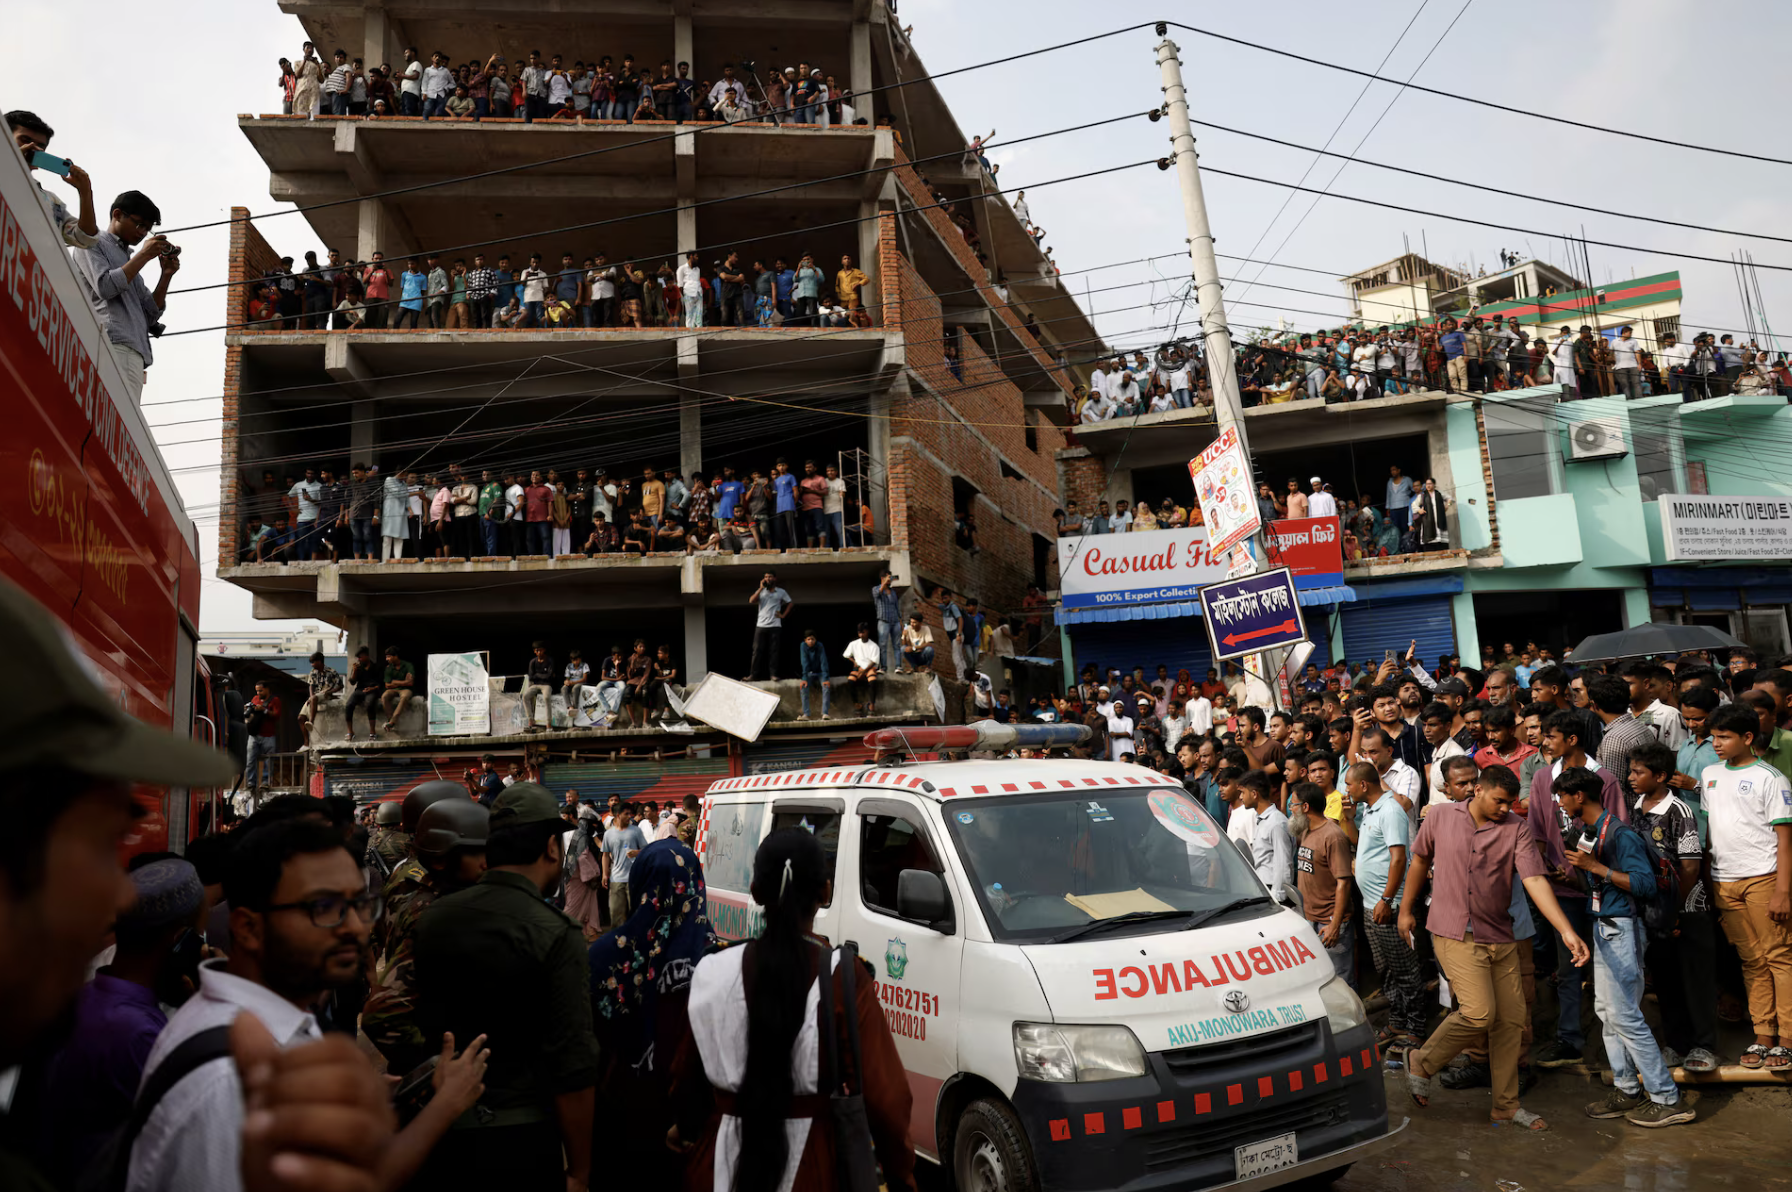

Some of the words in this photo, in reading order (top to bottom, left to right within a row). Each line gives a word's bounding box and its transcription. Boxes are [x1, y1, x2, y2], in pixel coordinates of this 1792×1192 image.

[29, 260, 88, 407] SERVICE
[85, 363, 95, 425] &
[95, 380, 117, 464] CIVIL
[116, 420, 151, 517] DEFENCE
[1203, 434, 1230, 465] UCC
[1311, 523, 1335, 544] ফিট
[1083, 542, 1177, 576] Casual
[1761, 547, 1773, 555] Food
[1095, 593, 1122, 603] 100%
[1125, 590, 1158, 601] Export
[1160, 587, 1198, 598] Collecti
[1210, 587, 1262, 626] মাইলস্টোন
[1258, 585, 1290, 614] কলেজ
[434, 687, 460, 695] GREEN
[460, 686, 486, 694] HOUSE
[449, 694, 482, 702] HOSTEL
[767, 761, 801, 770] KANSAI
[1167, 1008, 1279, 1047] AKIJ-MONOWARA
[1277, 1003, 1308, 1025] TRUST
